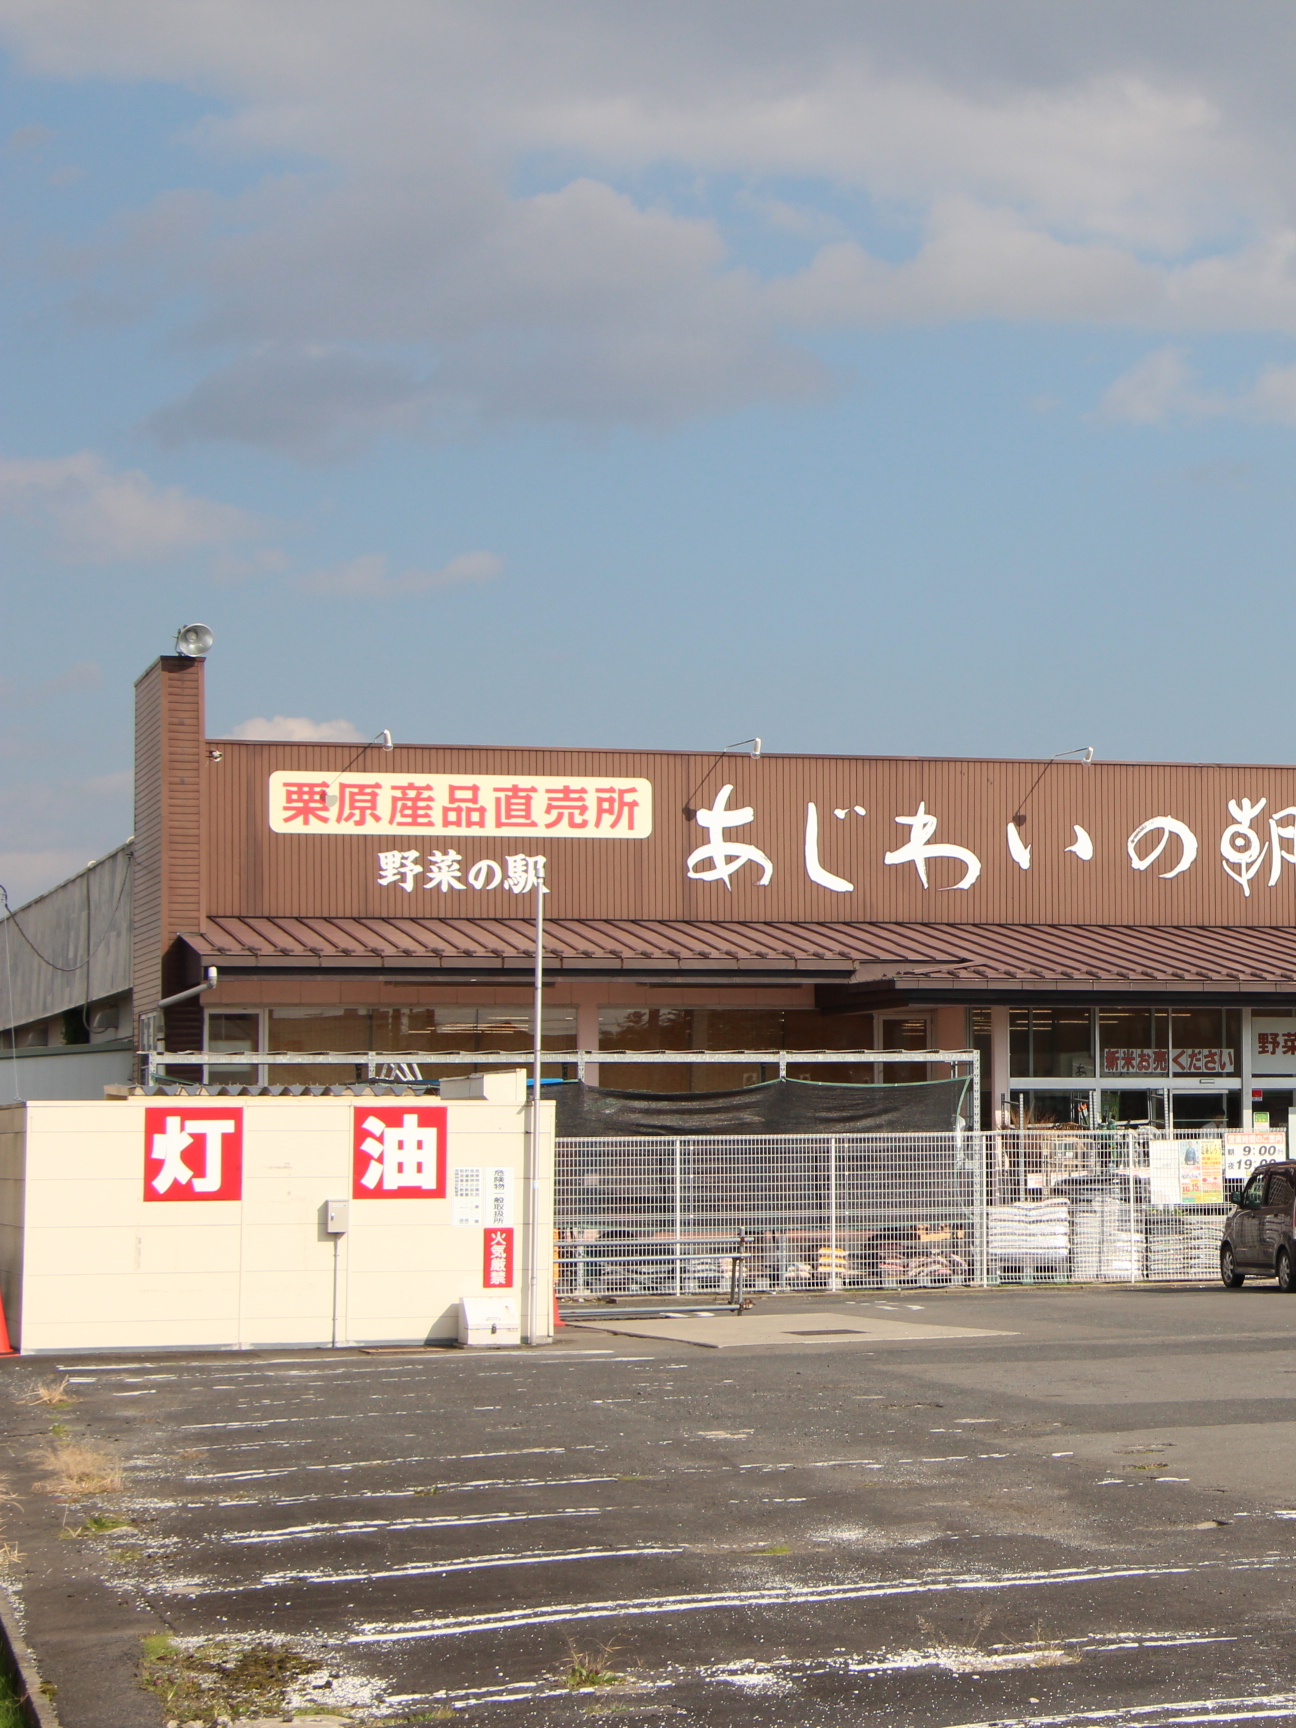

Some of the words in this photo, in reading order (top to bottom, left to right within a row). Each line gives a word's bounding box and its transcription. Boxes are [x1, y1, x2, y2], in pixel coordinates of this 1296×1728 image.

[282, 780, 640, 831] 栗原産品直売所
[377, 848, 550, 894] 野菜の駅
[1104, 1049, 1234, 1072] 新米お売ください
[150, 1115, 236, 1196] 灯
[359, 1113, 438, 1191] 油
[1227, 1134, 1283, 1145] 営業時間のご案内
[1242, 1145, 1277, 1157] 9:00
[490, 1230, 507, 1285] 火気厳禁
